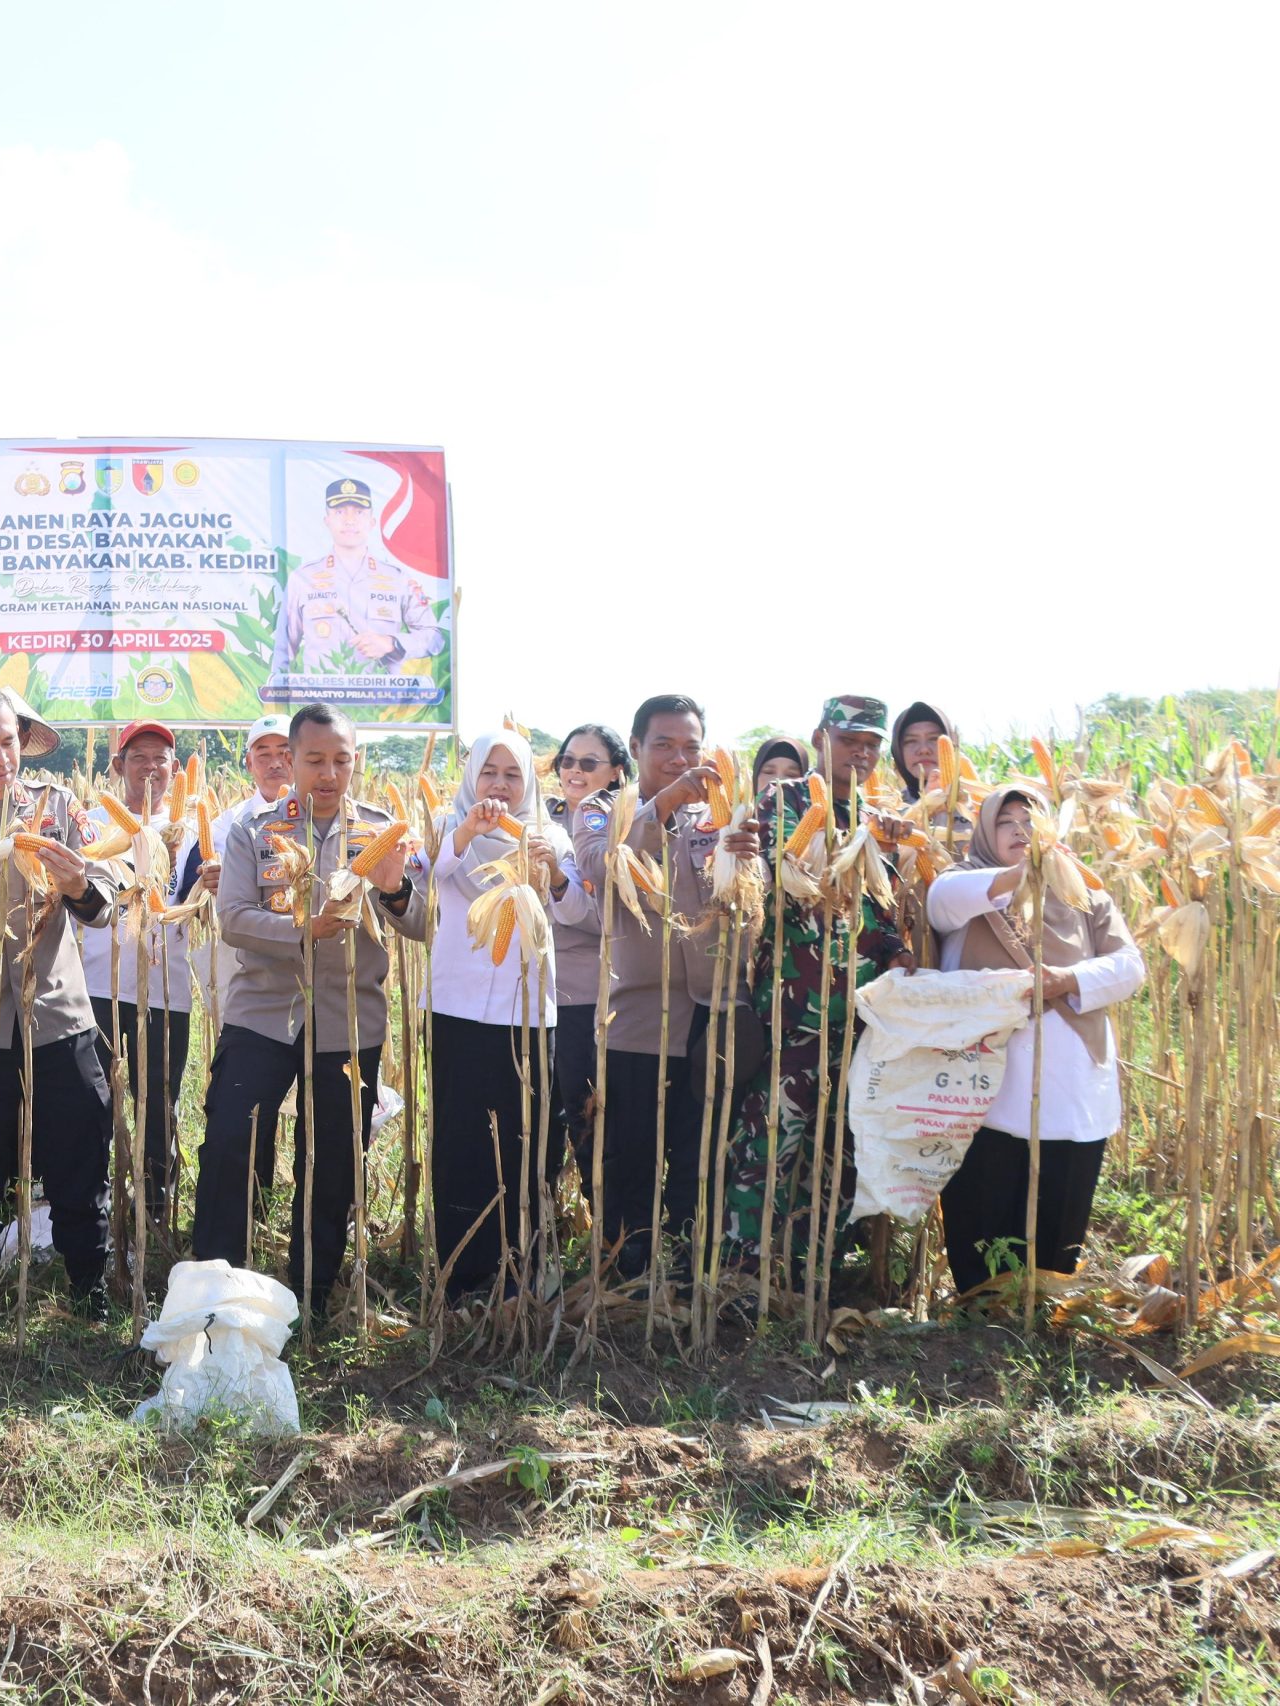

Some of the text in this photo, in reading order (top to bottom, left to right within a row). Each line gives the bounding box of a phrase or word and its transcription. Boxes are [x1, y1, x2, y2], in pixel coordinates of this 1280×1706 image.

[72, 512, 133, 528] RAYA
[140, 512, 232, 529] JAGUNG
[27, 533, 88, 550] DESA
[95, 532, 223, 549] BANYAKAN
[2, 552, 130, 571] BANYAKAN
[138, 553, 192, 569] KAB.
[199, 553, 275, 570] KEDIRI
[370, 593, 397, 602] POLRI
[41, 601, 120, 612] KETAHANAN
[125, 601, 179, 610] PANGAN
[182, 601, 248, 611] NASIONAL
[7, 633, 212, 650] KEDIRI, 30 APRIL 2025
[283, 677, 420, 687] KAPOLRES KEDIRI KOTA
[48, 686, 118, 698] PRESISI
[292, 690, 345, 698] BRAMASTYO
[935, 1072, 949, 1087] G
[928, 1093, 969, 1105] PAKAN
[914, 1118, 945, 1128] PAKAN
